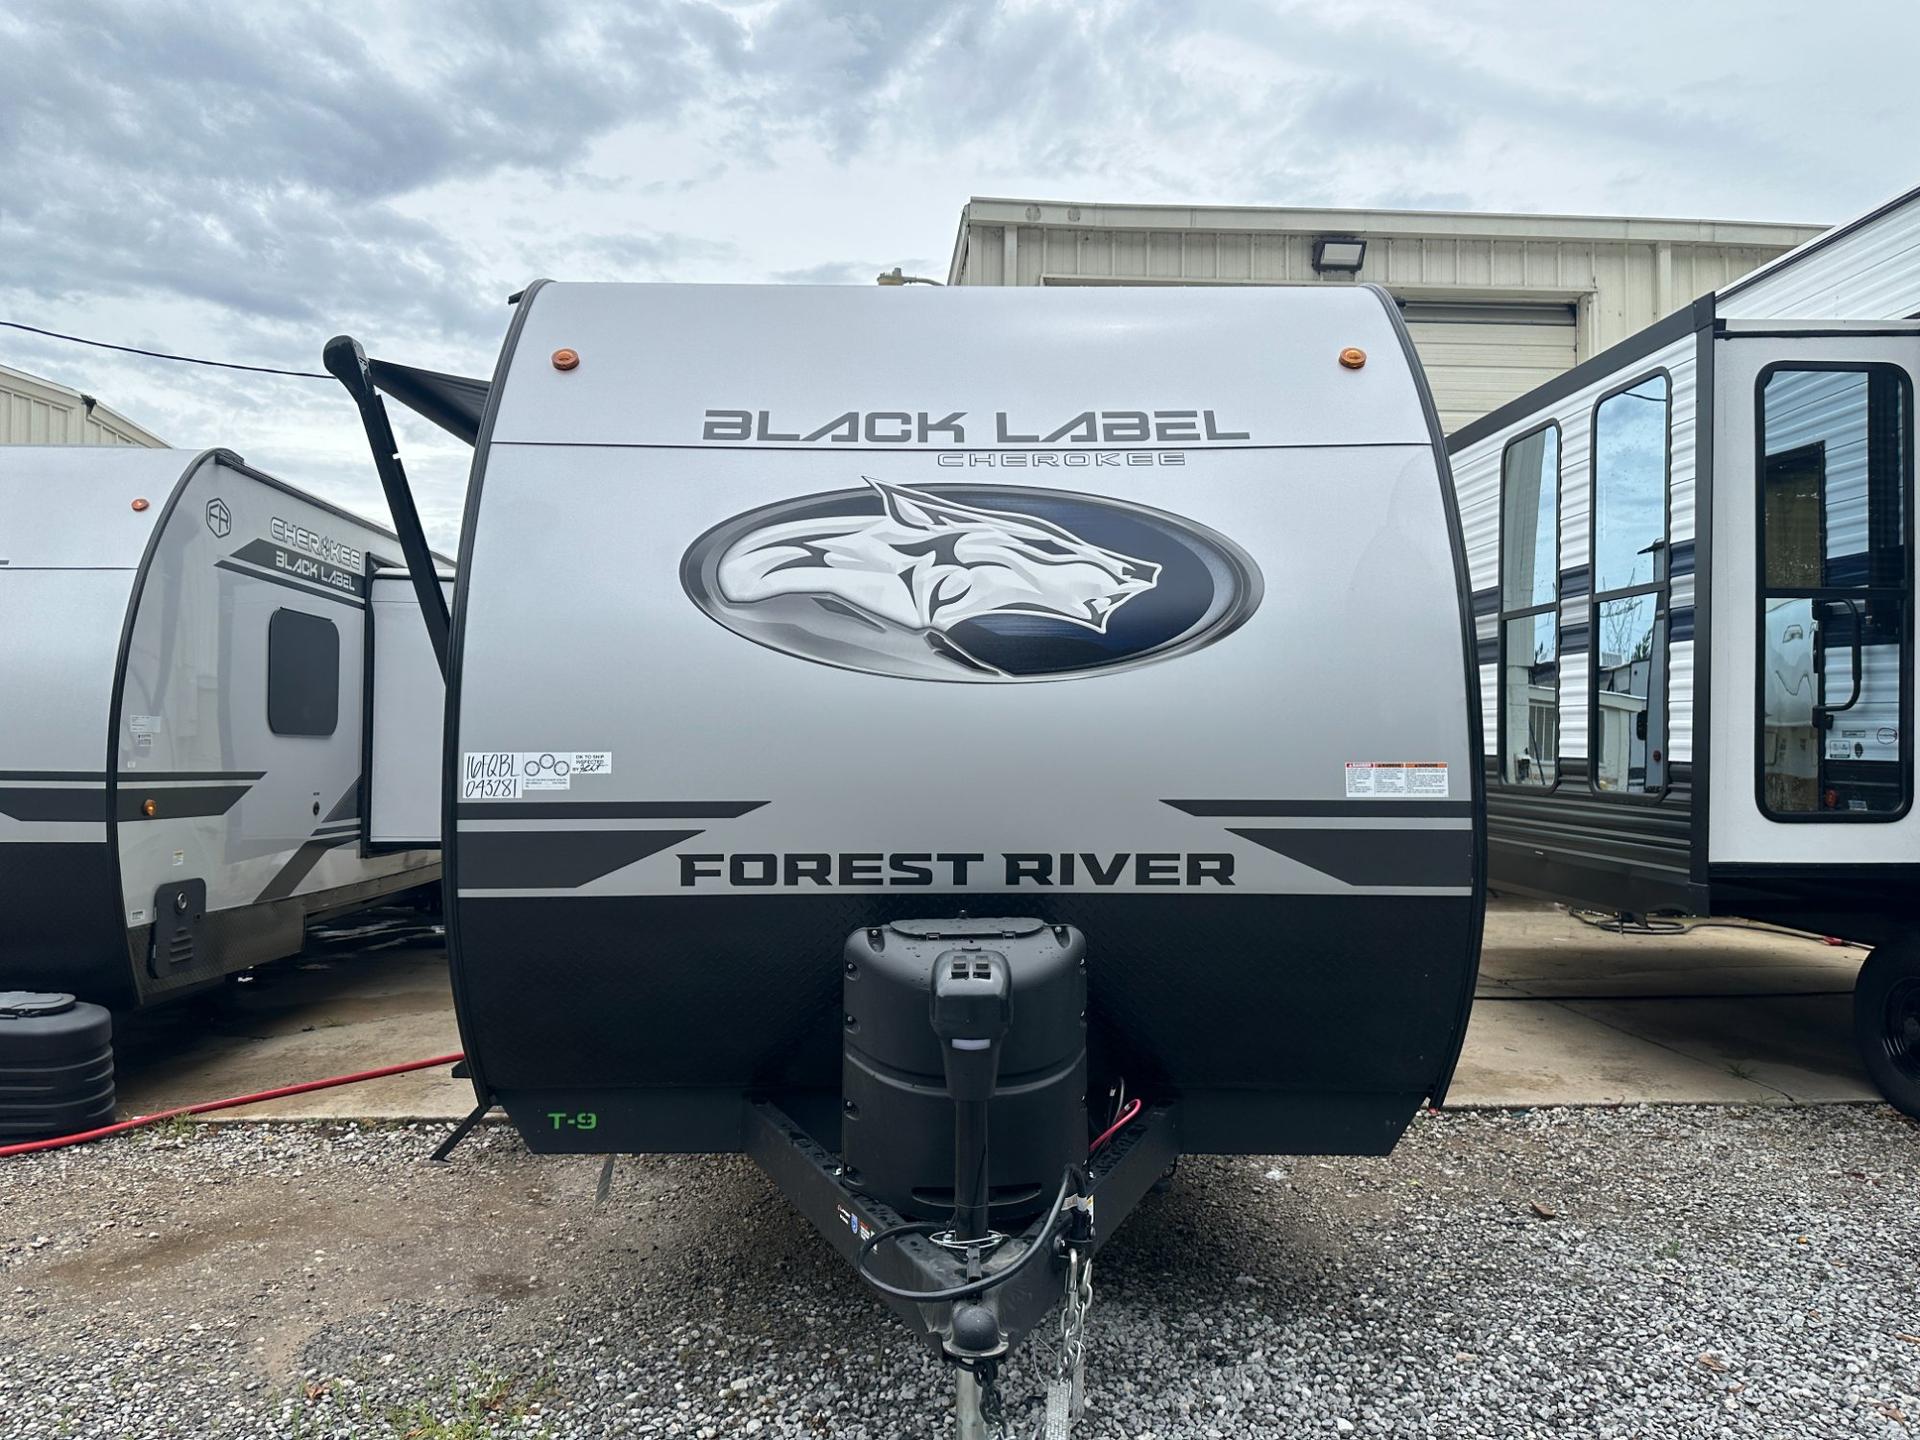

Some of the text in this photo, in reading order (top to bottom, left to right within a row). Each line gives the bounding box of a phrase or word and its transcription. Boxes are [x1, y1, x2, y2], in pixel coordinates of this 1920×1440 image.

[703, 409, 1250, 443] BLACK LABEL
[937, 452, 1186, 467] CHEROKEE
[275, 551, 355, 591] BLACK LABEL
[675, 853, 1236, 886] FOREST RIVER
[547, 1112, 597, 1129] T-9
